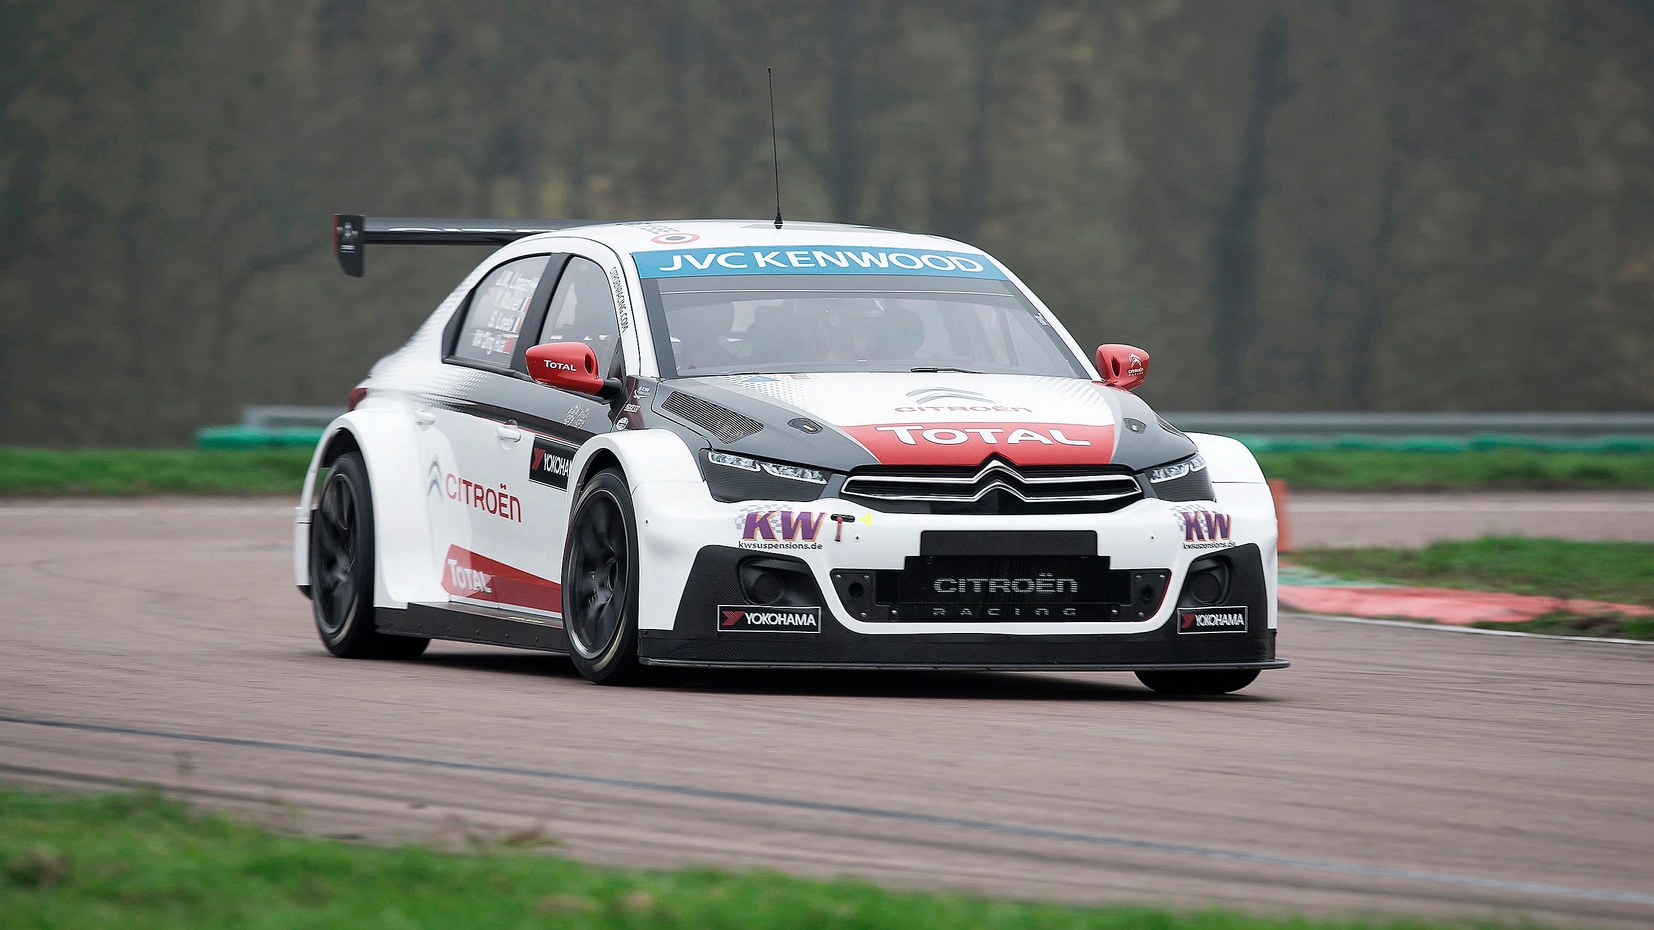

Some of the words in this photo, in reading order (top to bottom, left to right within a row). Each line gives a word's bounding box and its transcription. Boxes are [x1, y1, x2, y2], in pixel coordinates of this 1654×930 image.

[659, 252, 749, 271] JVC
[752, 251, 985, 273] KENWOOD
[544, 359, 577, 372] TOTAL
[874, 425, 1092, 446] TOTAL
[446, 473, 522, 523] CITROËN
[742, 510, 827, 542] KW
[1180, 510, 1231, 542] KW
[738, 541, 823, 550] kwsuspensions.de
[447, 558, 493, 594] TOTAL
[933, 572, 1078, 593] CITROËN
[744, 612, 817, 626] YOKOHAMA
[932, 607, 1077, 616] RACING
[1195, 613, 1245, 626] YOKOHAMA
